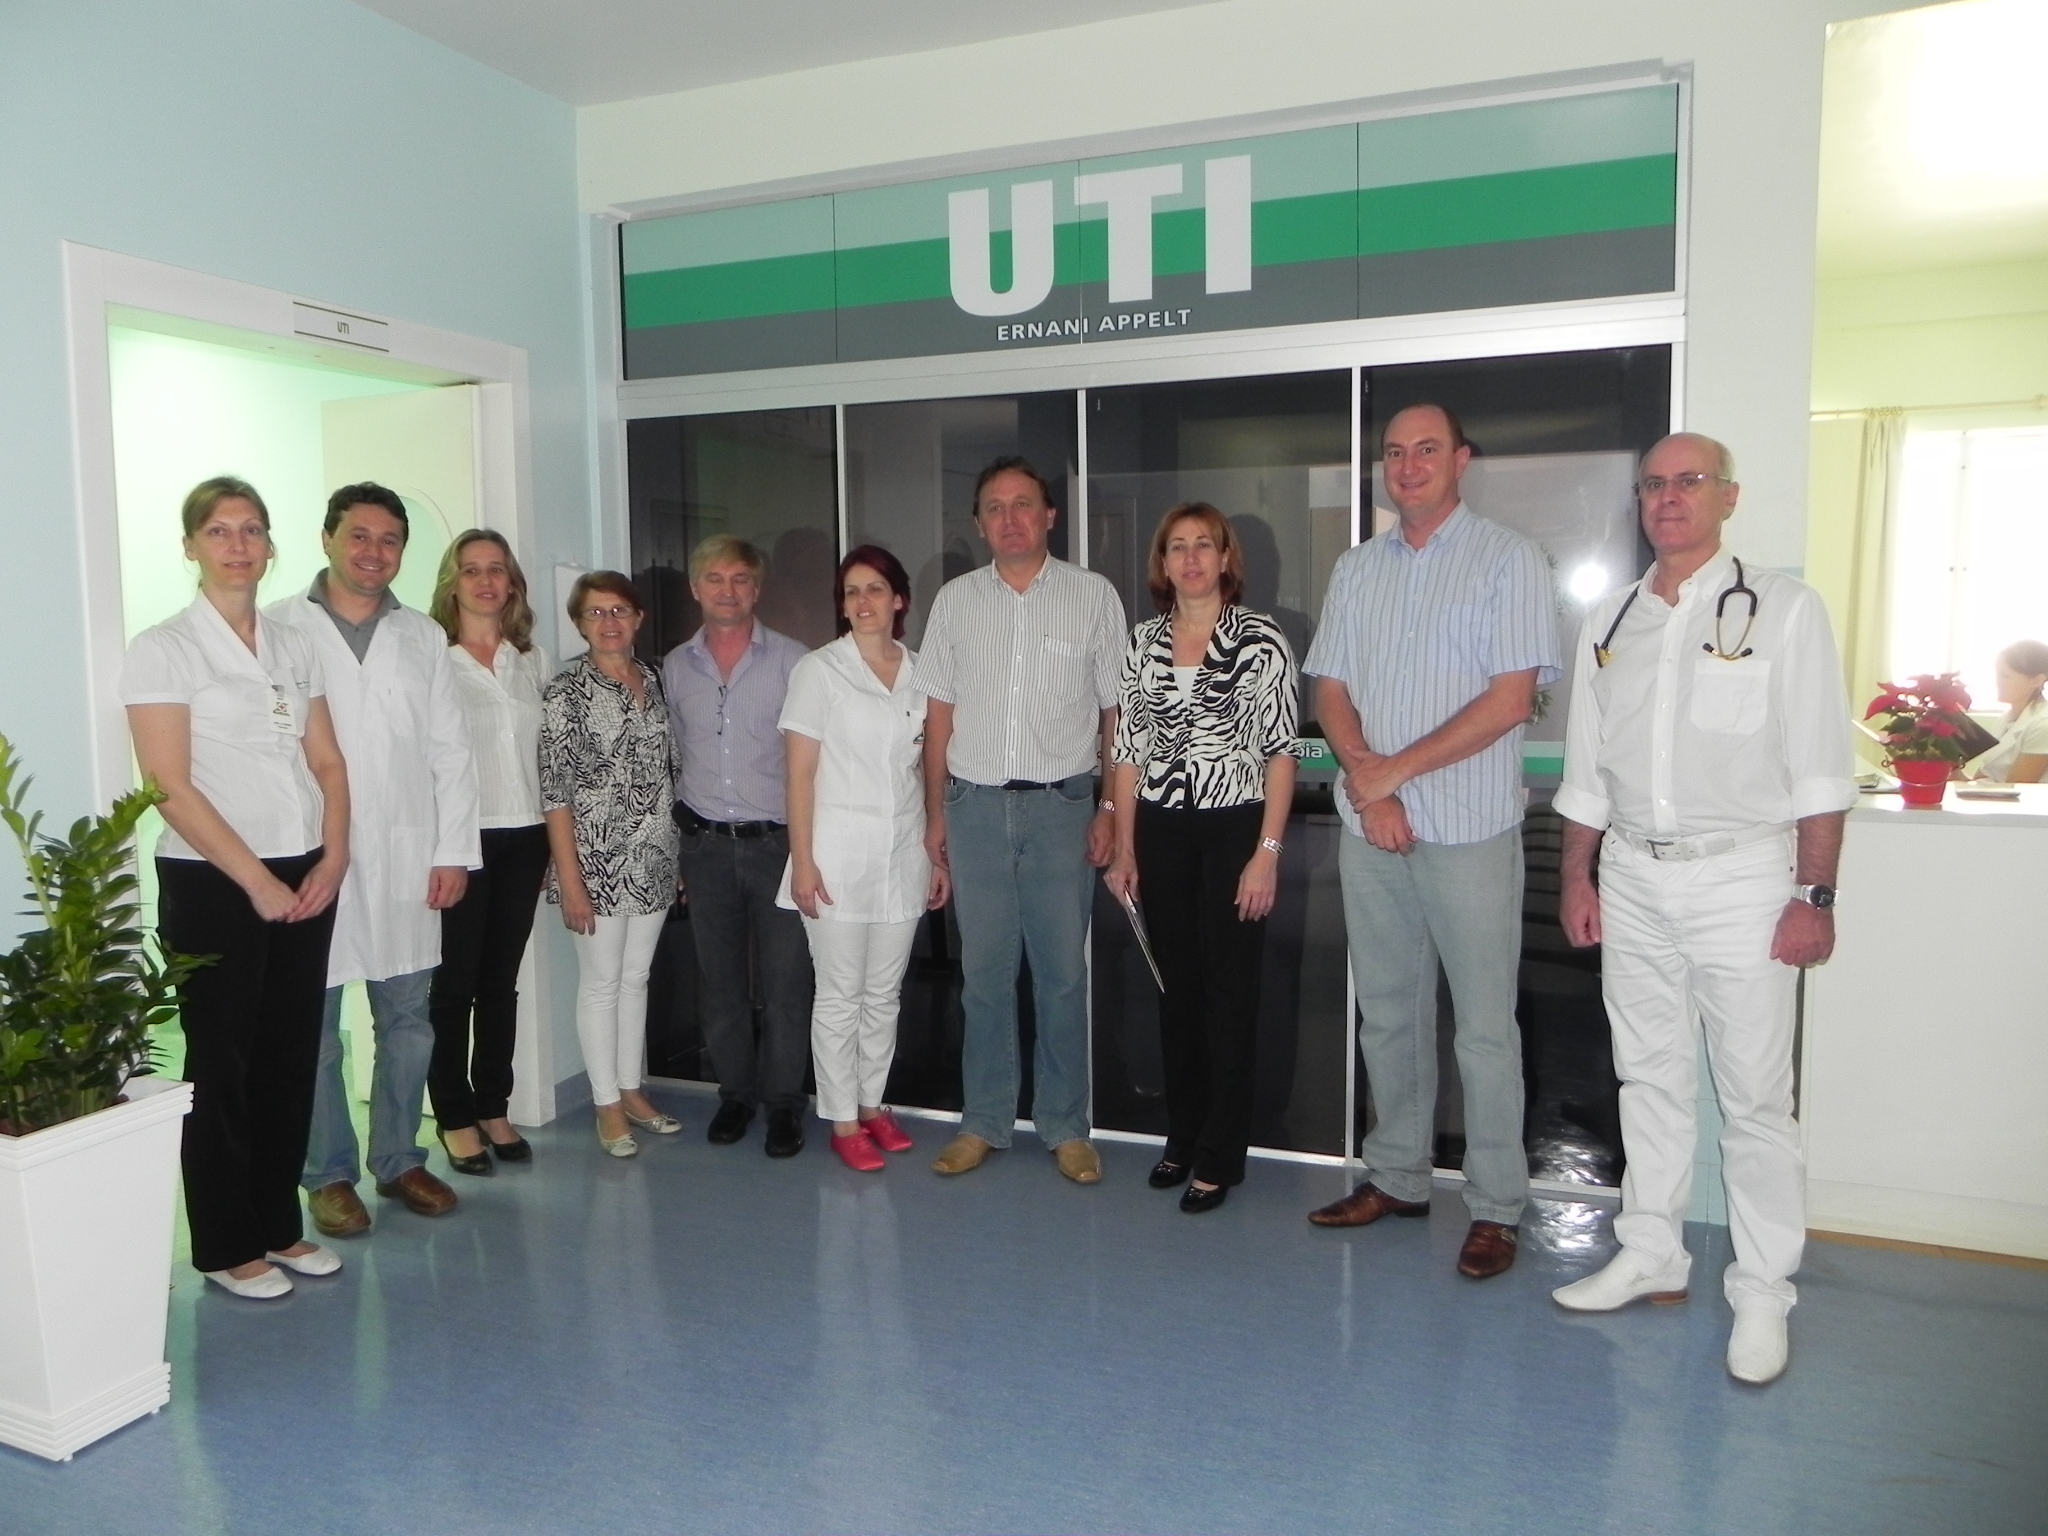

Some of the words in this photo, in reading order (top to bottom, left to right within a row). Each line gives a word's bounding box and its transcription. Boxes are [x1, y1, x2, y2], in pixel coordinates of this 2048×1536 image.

[948, 155, 1252, 317] UTI
[337, 321, 350, 335] UTI
[997, 318, 1089, 341] ERNANI
[1098, 308, 1192, 333] APPELT
